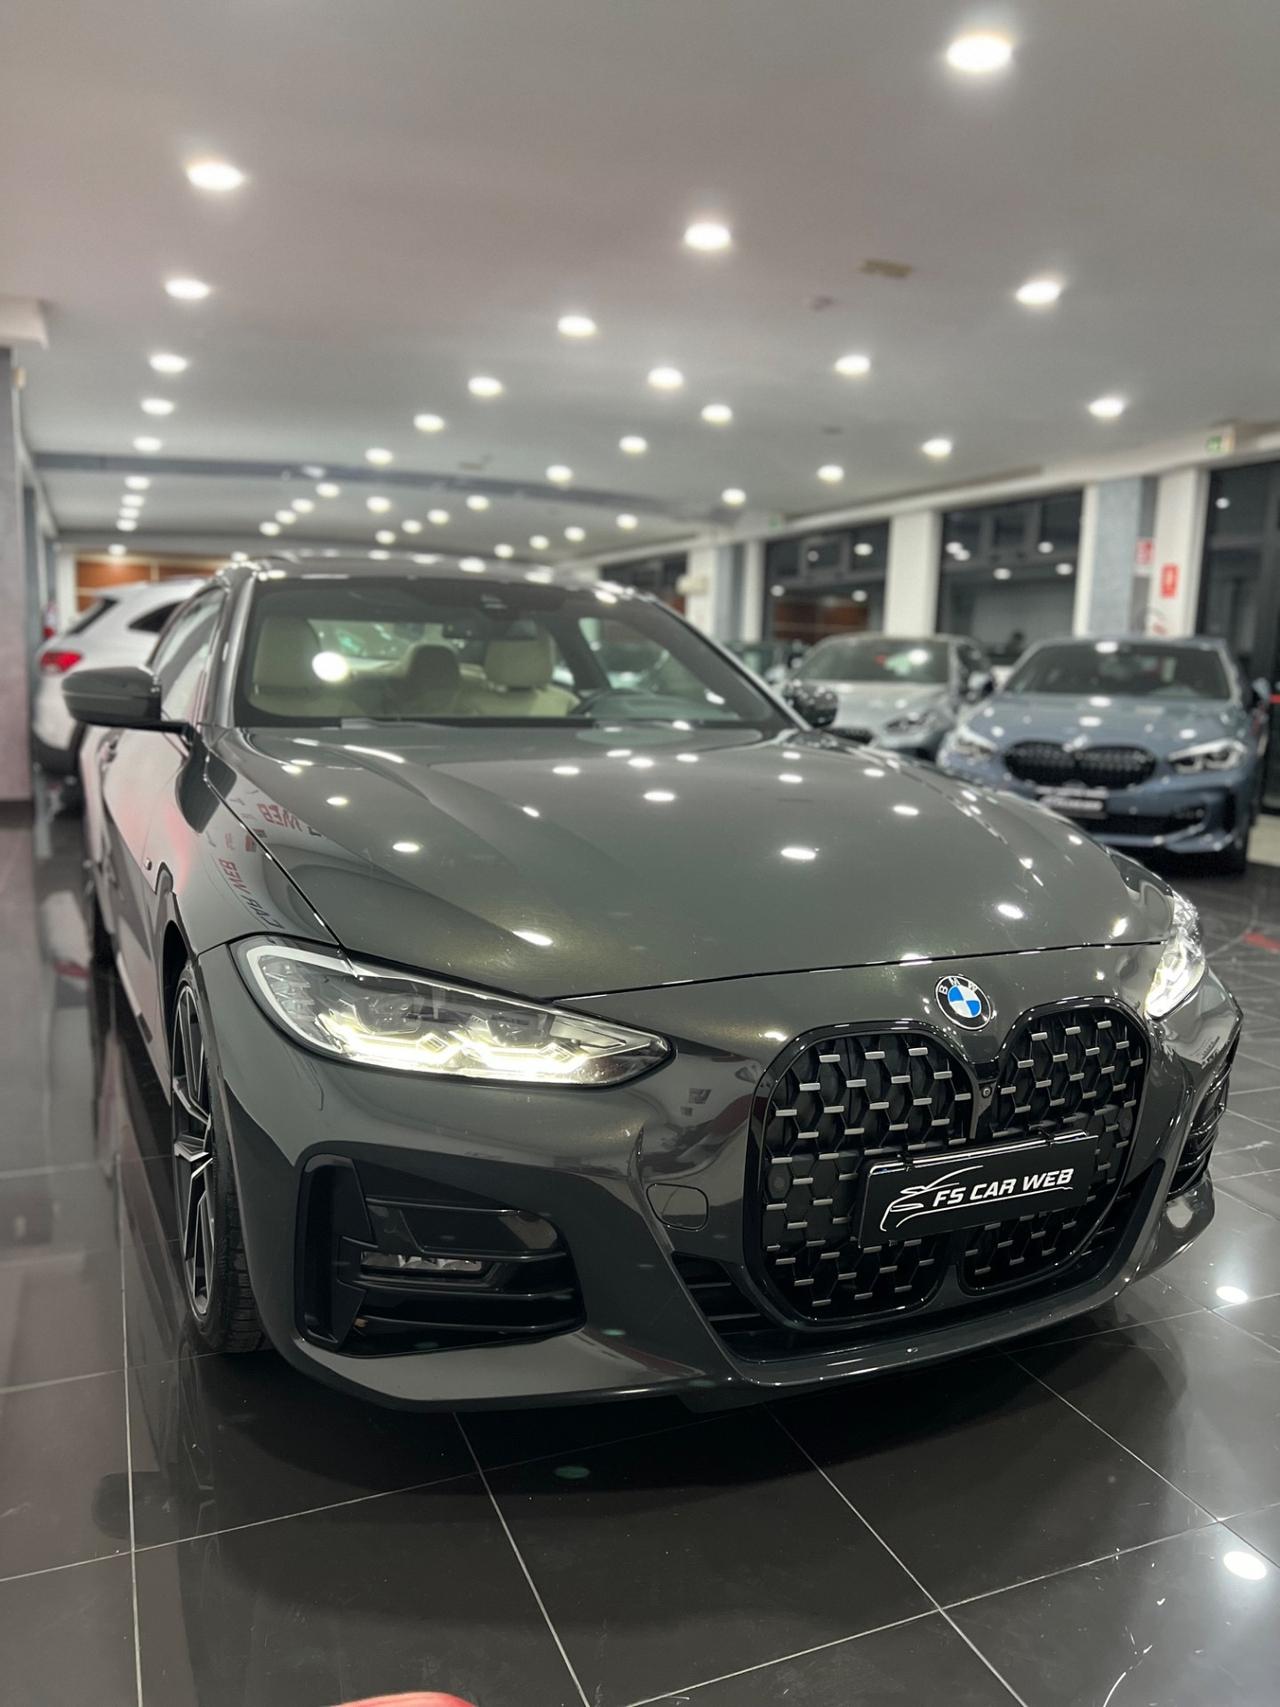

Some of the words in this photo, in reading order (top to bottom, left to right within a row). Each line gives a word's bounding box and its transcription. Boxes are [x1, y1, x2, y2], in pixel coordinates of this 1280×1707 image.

[932, 1187, 967, 1207] FS
[969, 1178, 1017, 1201] CAR
[1022, 1168, 1075, 1191] WEB
